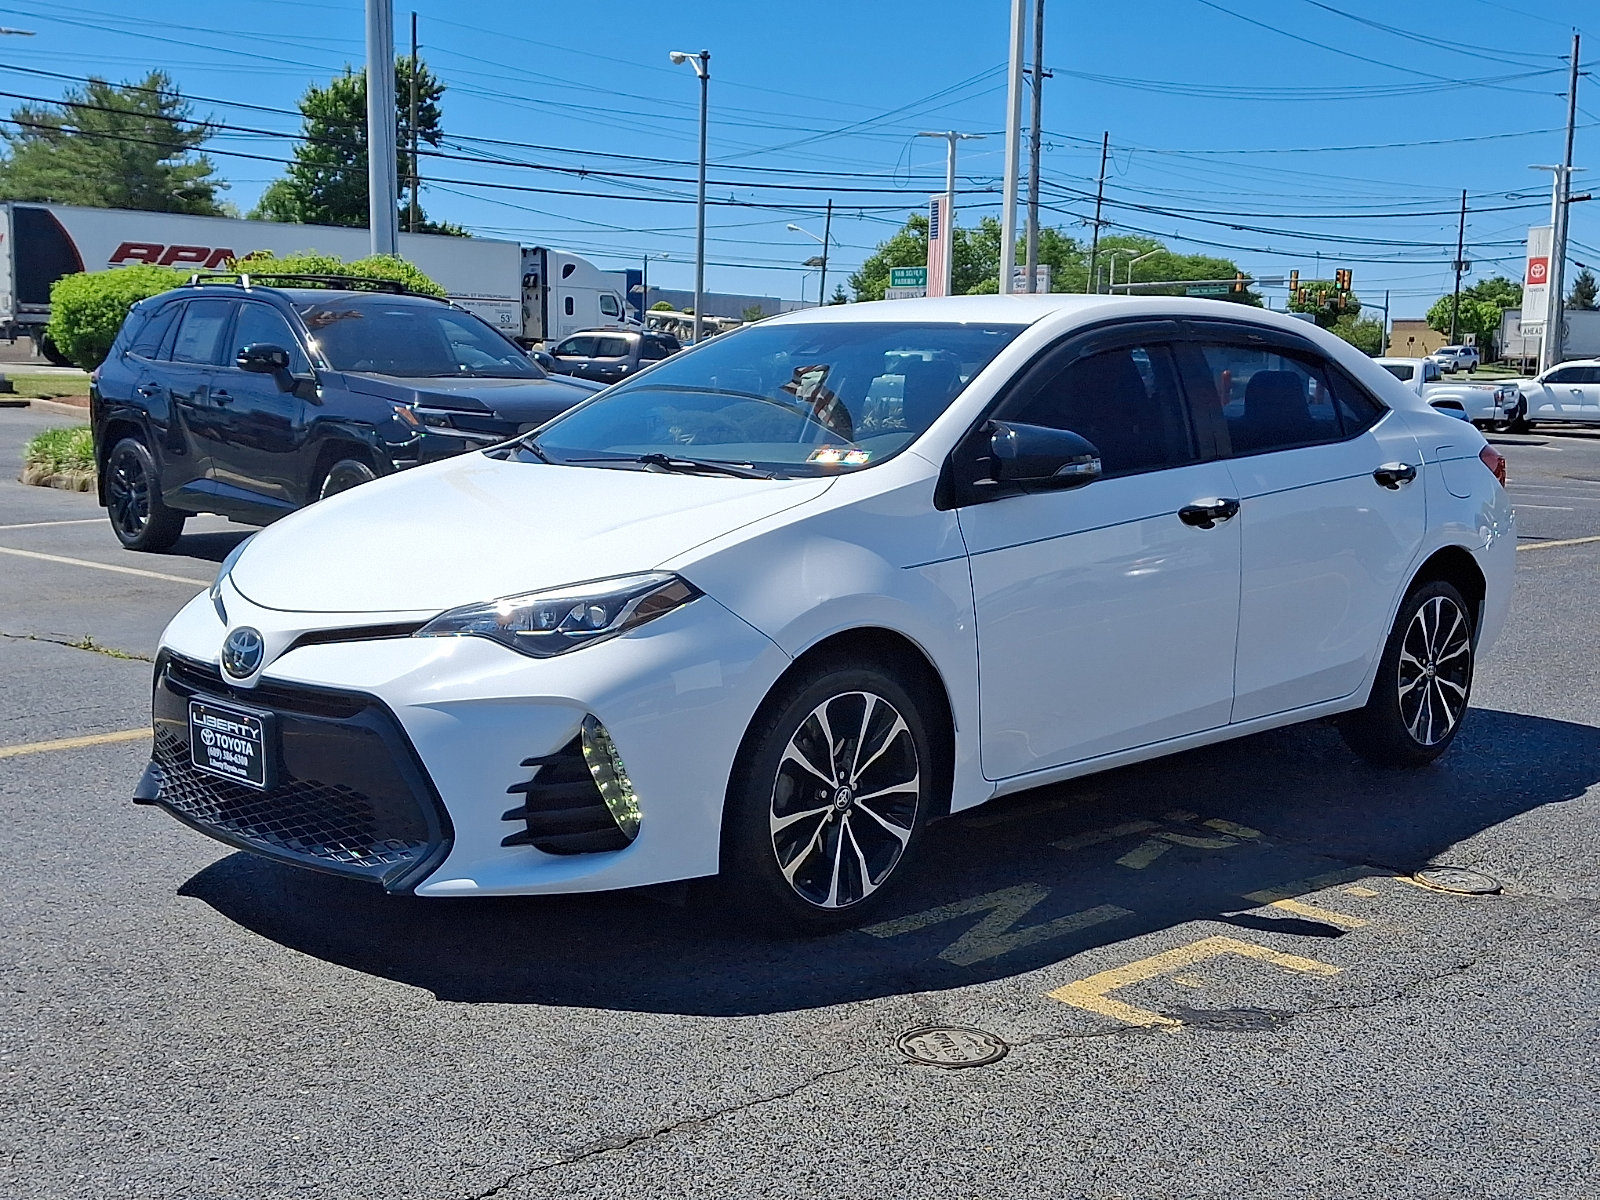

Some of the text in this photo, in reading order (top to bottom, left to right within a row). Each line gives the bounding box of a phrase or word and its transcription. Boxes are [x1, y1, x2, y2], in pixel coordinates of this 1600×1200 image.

[1523, 327, 1543, 335] AHEAD
[193, 711, 259, 738] LIBERTY
[215, 733, 254, 756] TOYOTA
